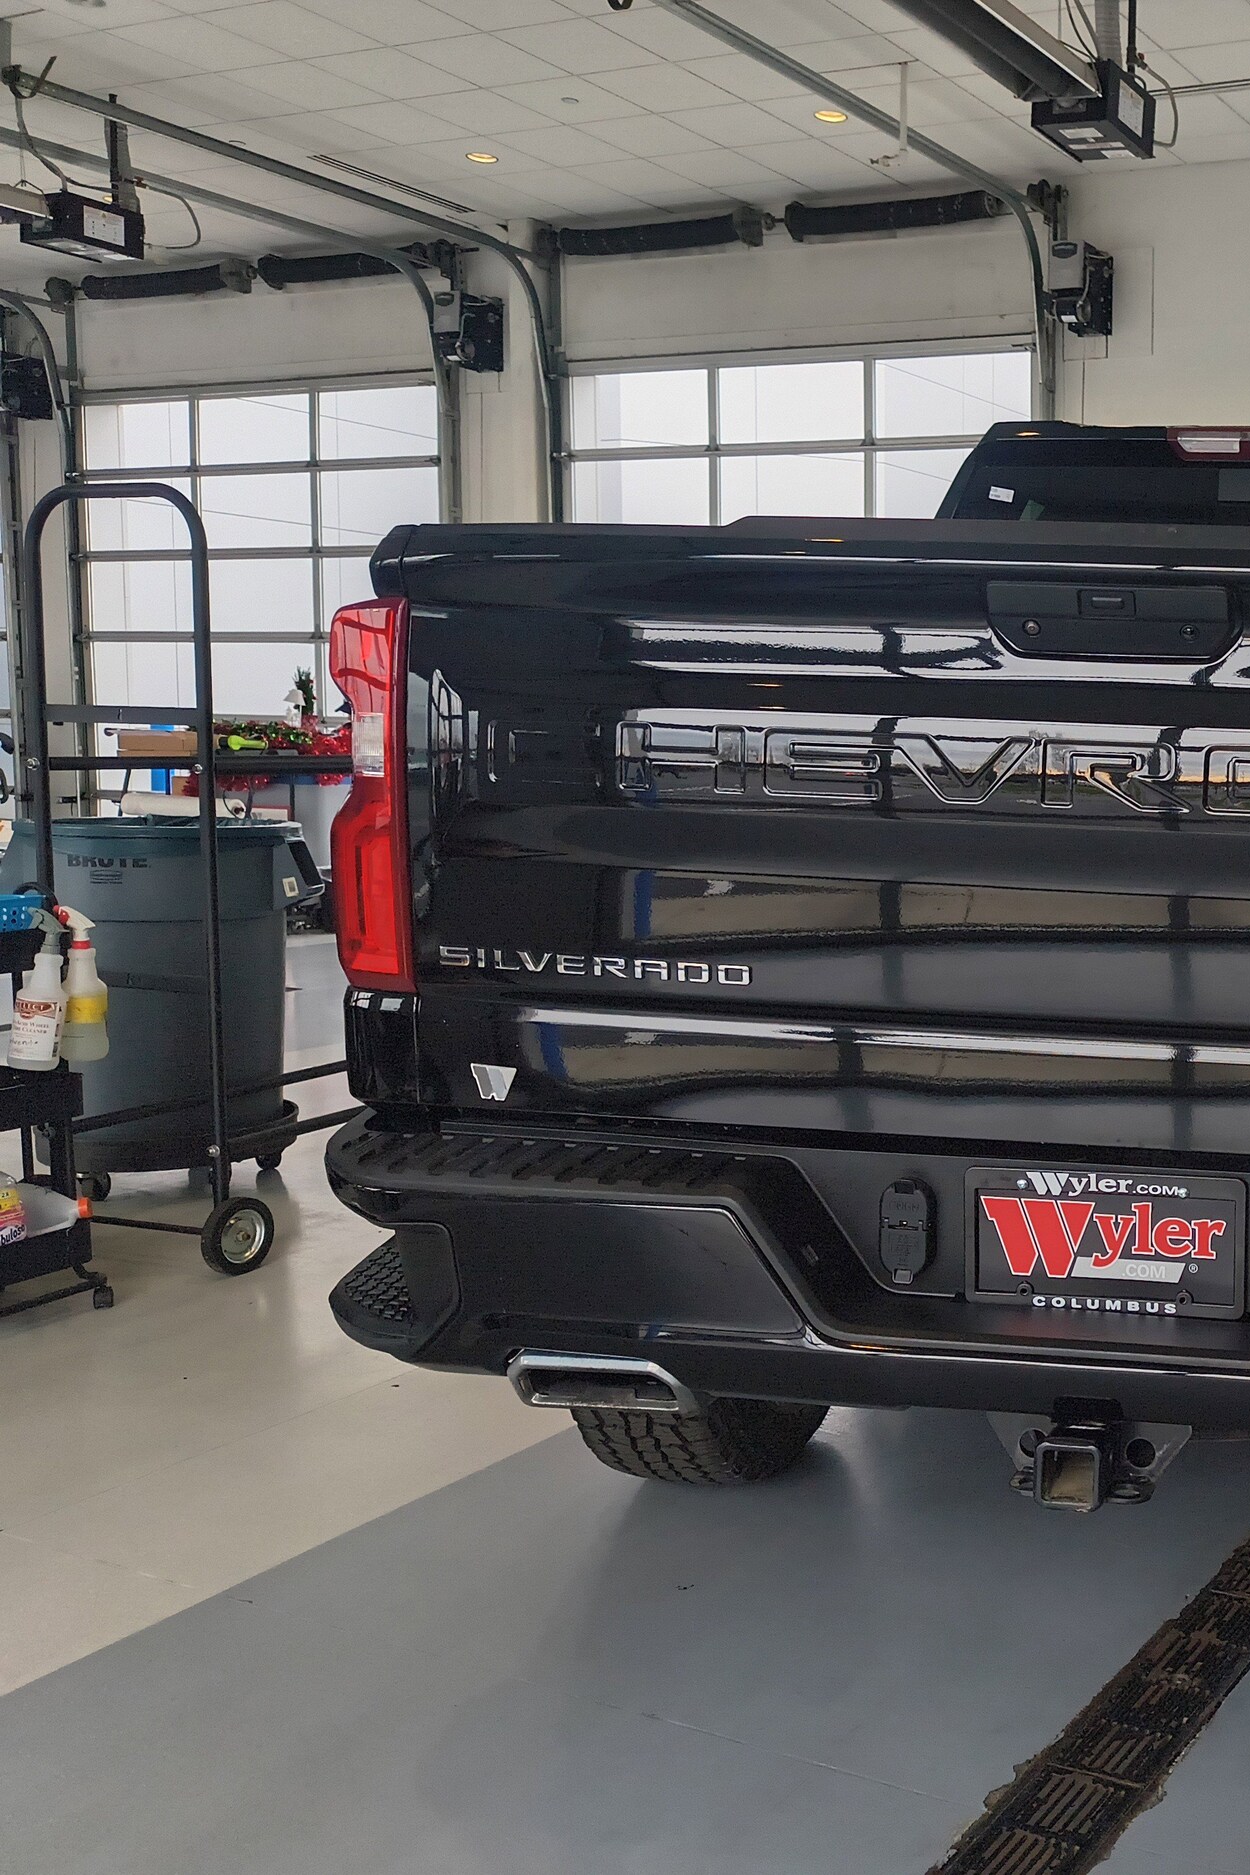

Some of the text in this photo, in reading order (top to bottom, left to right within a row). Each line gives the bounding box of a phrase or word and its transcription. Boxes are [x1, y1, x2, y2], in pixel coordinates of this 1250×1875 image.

[439, 945, 753, 987] SILVERADO
[980, 1196, 1226, 1278] Wyler
[1032, 1295, 1177, 1314] COLUMBUS
